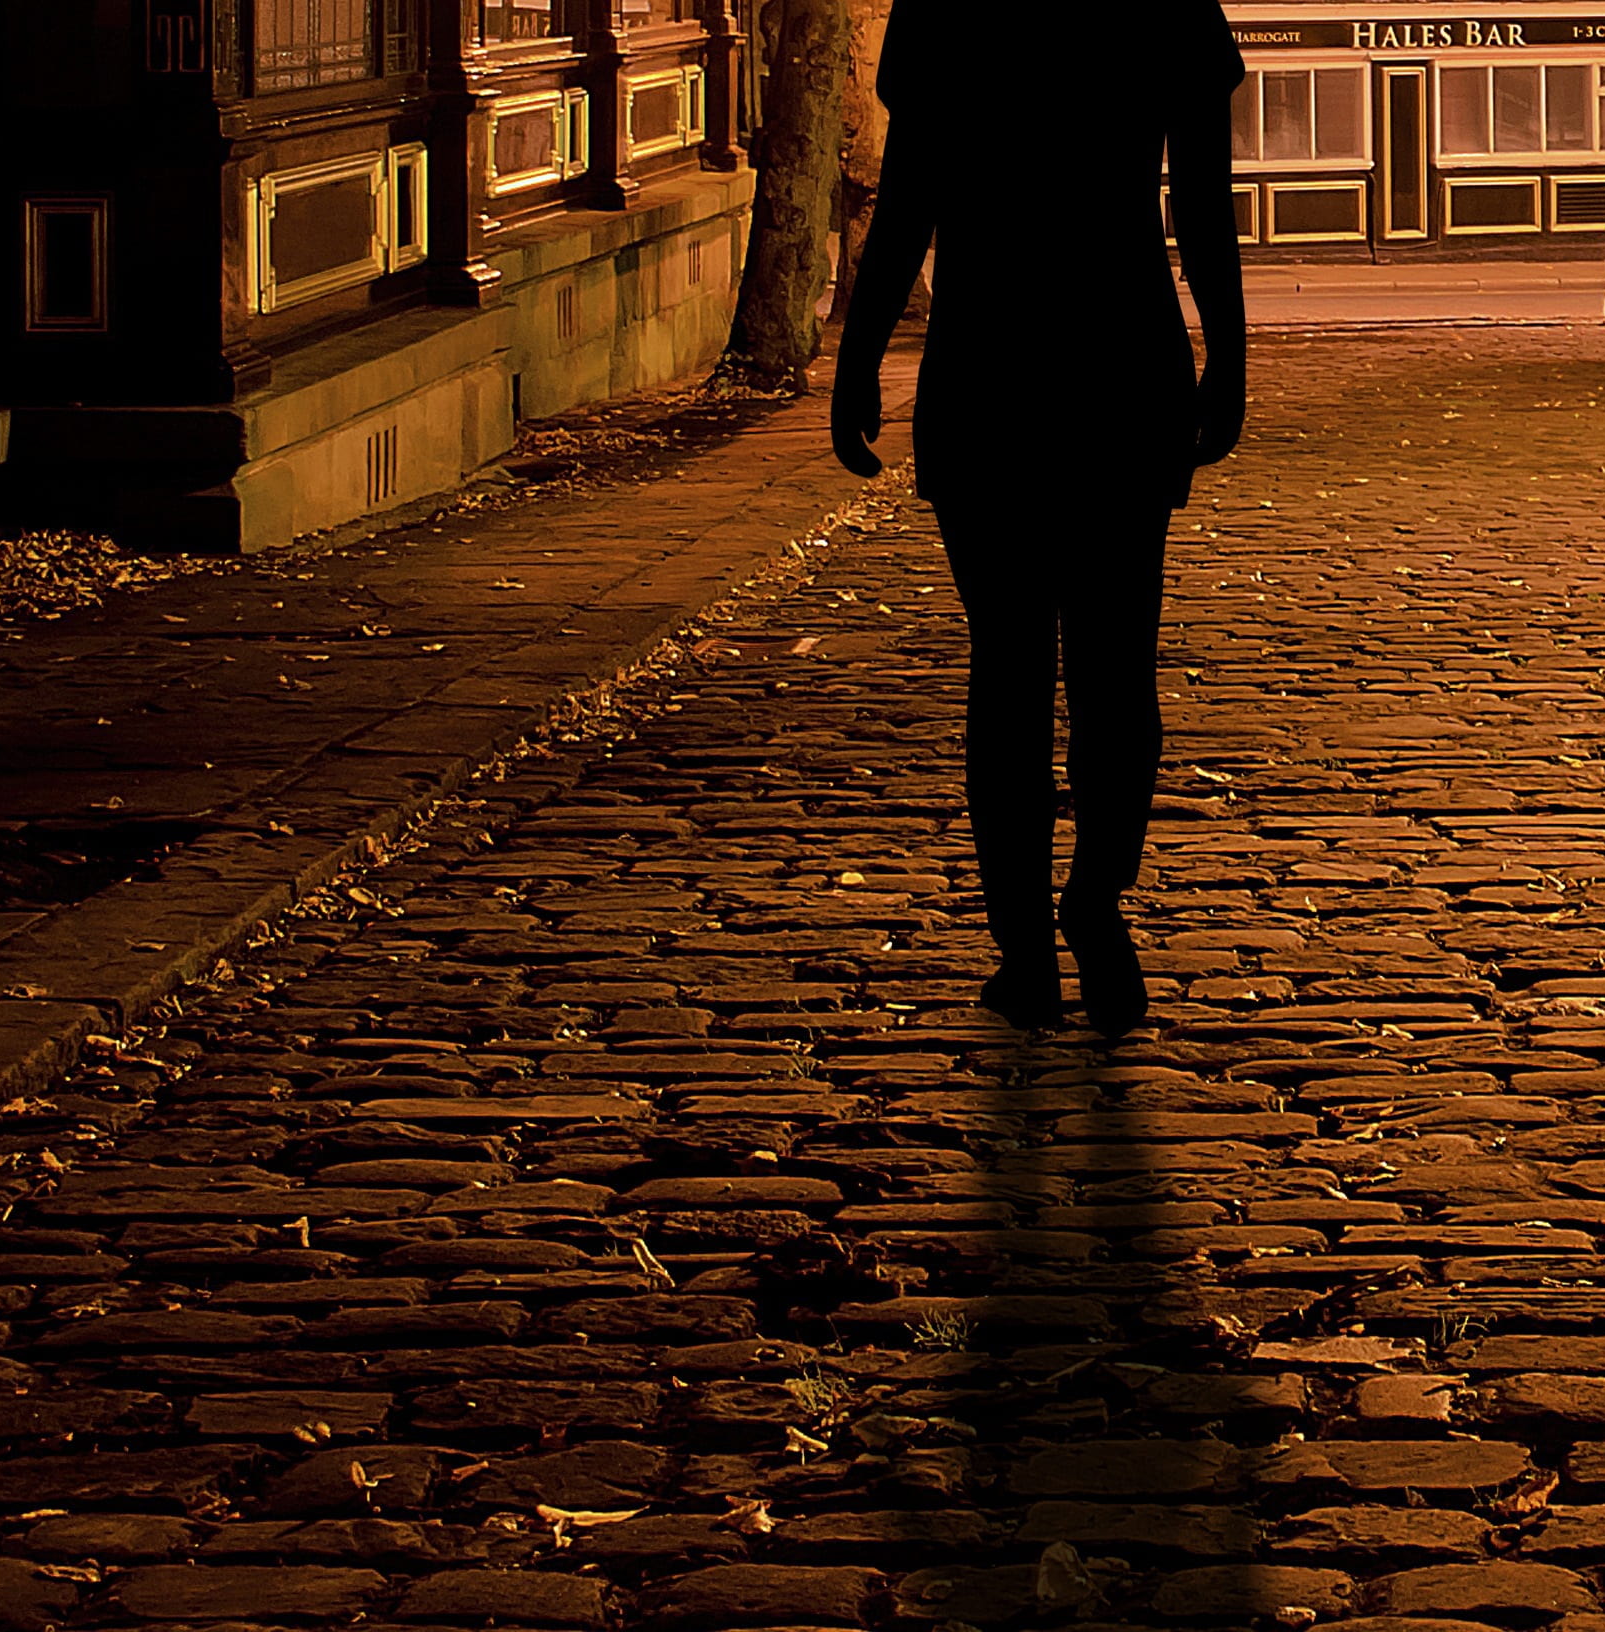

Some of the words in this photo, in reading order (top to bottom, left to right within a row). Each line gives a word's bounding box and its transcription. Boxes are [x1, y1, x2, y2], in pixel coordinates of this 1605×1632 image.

[1233, 31, 1301, 43] HARROGATE
[1353, 22, 1452, 49] HALES
[1465, 20, 1526, 47] BAR
